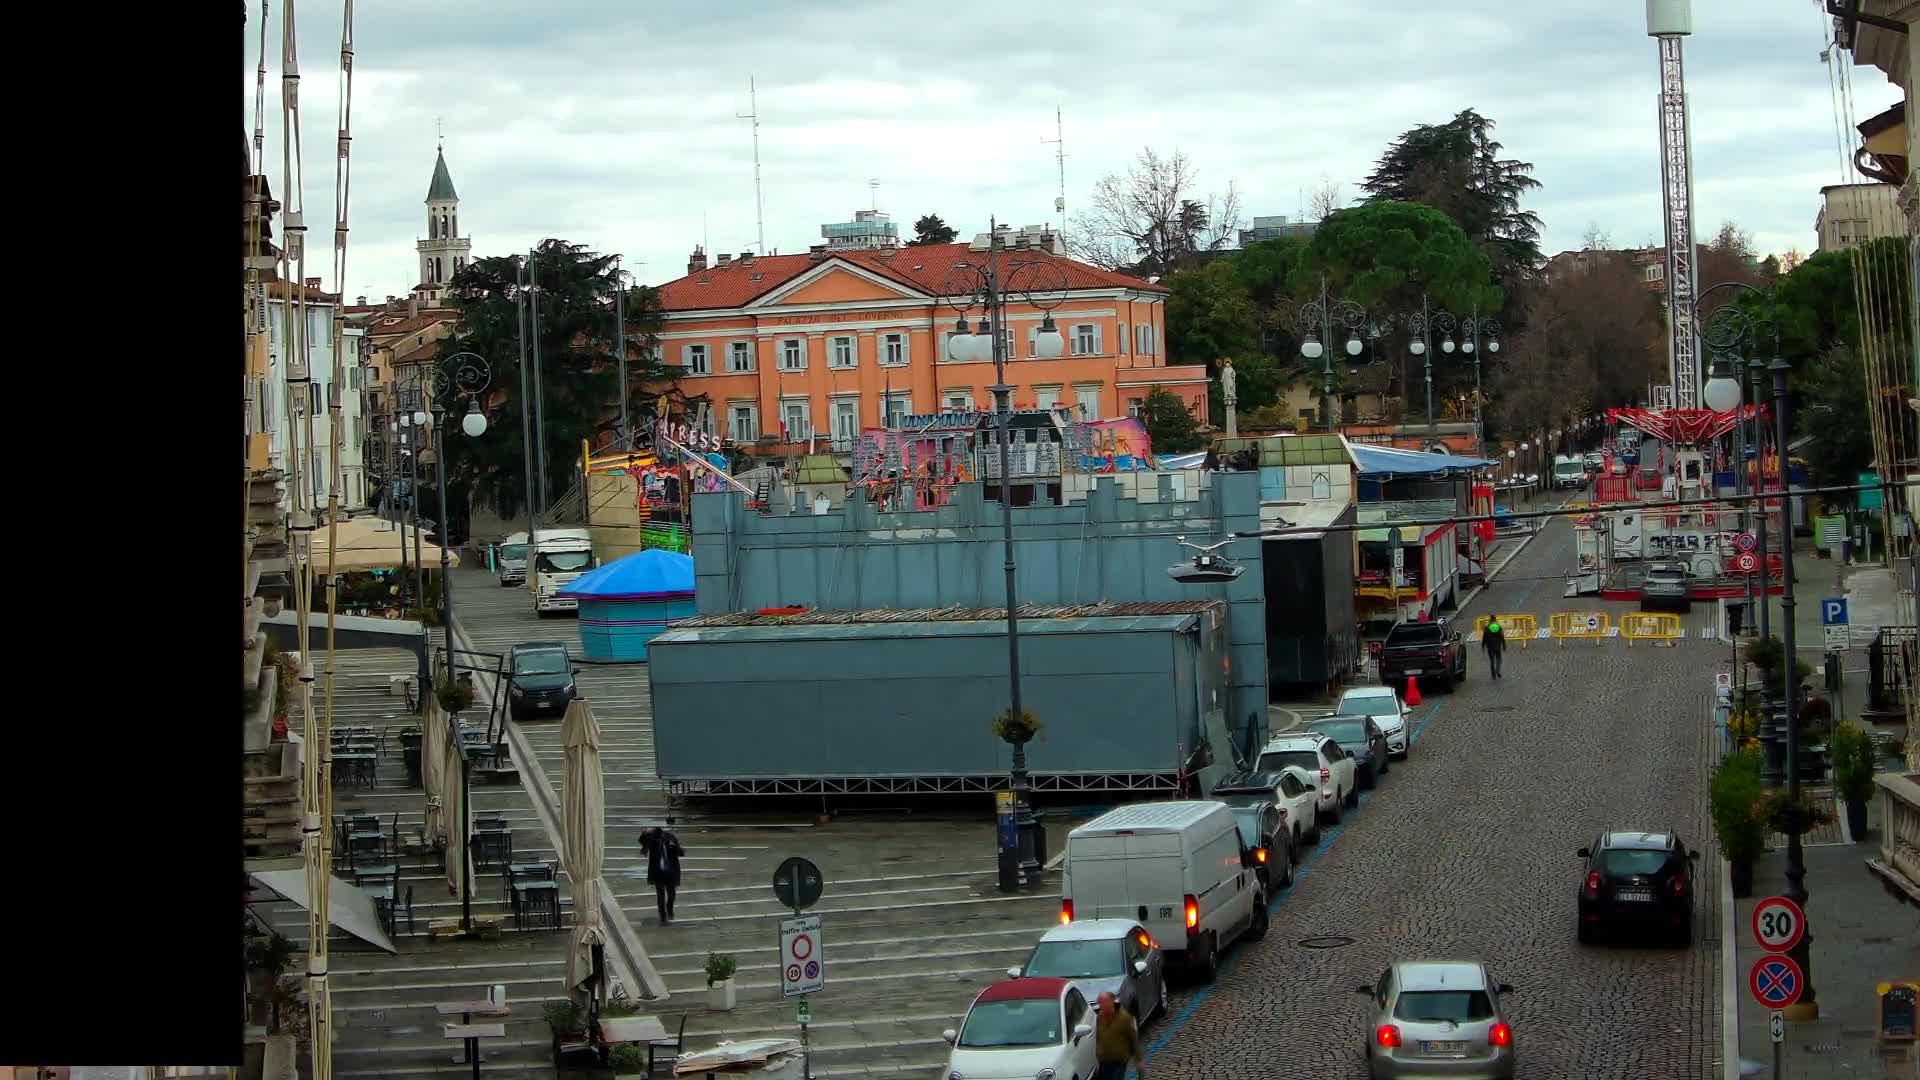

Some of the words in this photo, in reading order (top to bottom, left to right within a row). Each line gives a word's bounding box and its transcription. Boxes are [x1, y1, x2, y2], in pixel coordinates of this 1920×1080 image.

[1742, 557, 1752, 567] 20
[1827, 602, 1842, 622] P
[1762, 911, 1792, 938] 30
